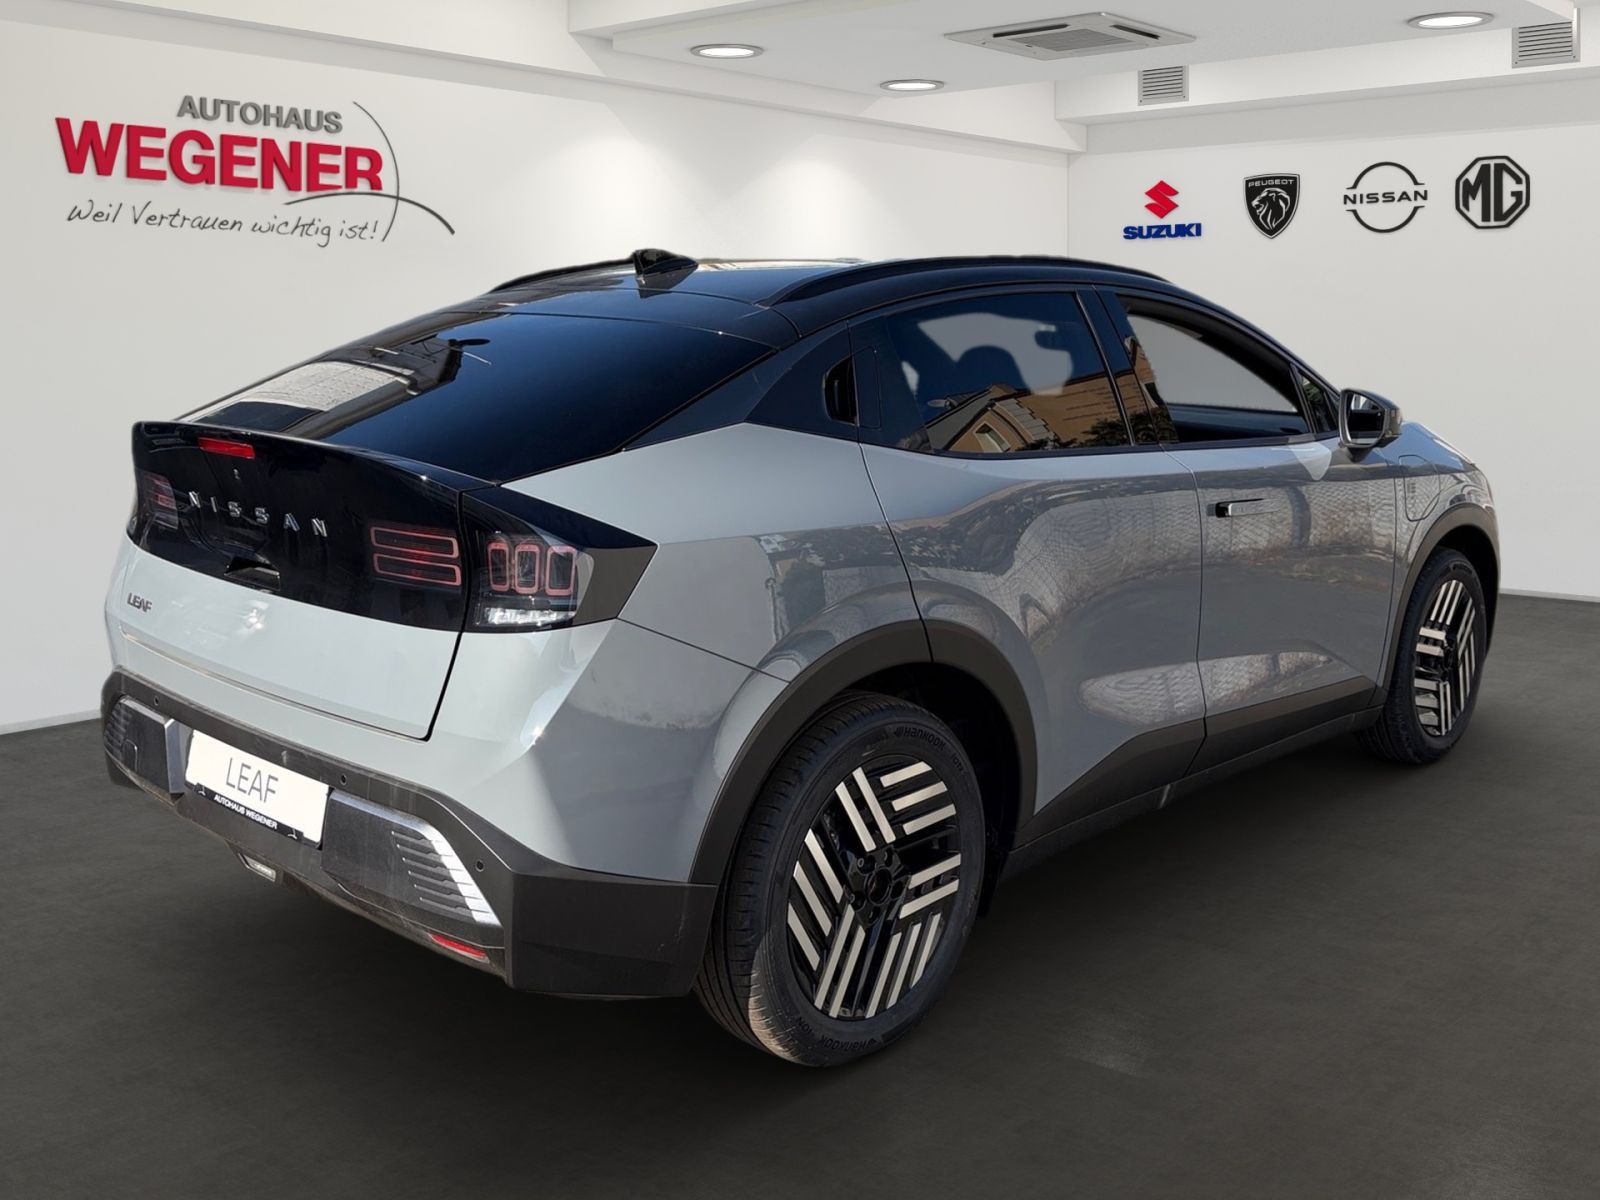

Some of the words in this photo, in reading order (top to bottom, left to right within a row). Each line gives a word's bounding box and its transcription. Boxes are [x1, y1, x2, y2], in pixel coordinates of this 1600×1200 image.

[177, 95, 343, 134] AUTOHAUS
[55, 117, 384, 193] WEGENER
[1248, 178, 1295, 188] PEUGEOT
[1343, 188, 1428, 206] NISSAN
[1460, 160, 1526, 225] MG
[67, 199, 121, 224] Weil
[131, 200, 243, 233] Vertrauen
[251, 217, 331, 248] wichtig
[338, 220, 378, 241] ist!
[1122, 222, 1203, 240] SUZUKI
[188, 490, 328, 538] NISSAN
[127, 592, 153, 613] LEAF
[225, 757, 279, 803] LEAF
[213, 794, 246, 815] AUTOHAUS
[245, 808, 279, 830] WEGENER
